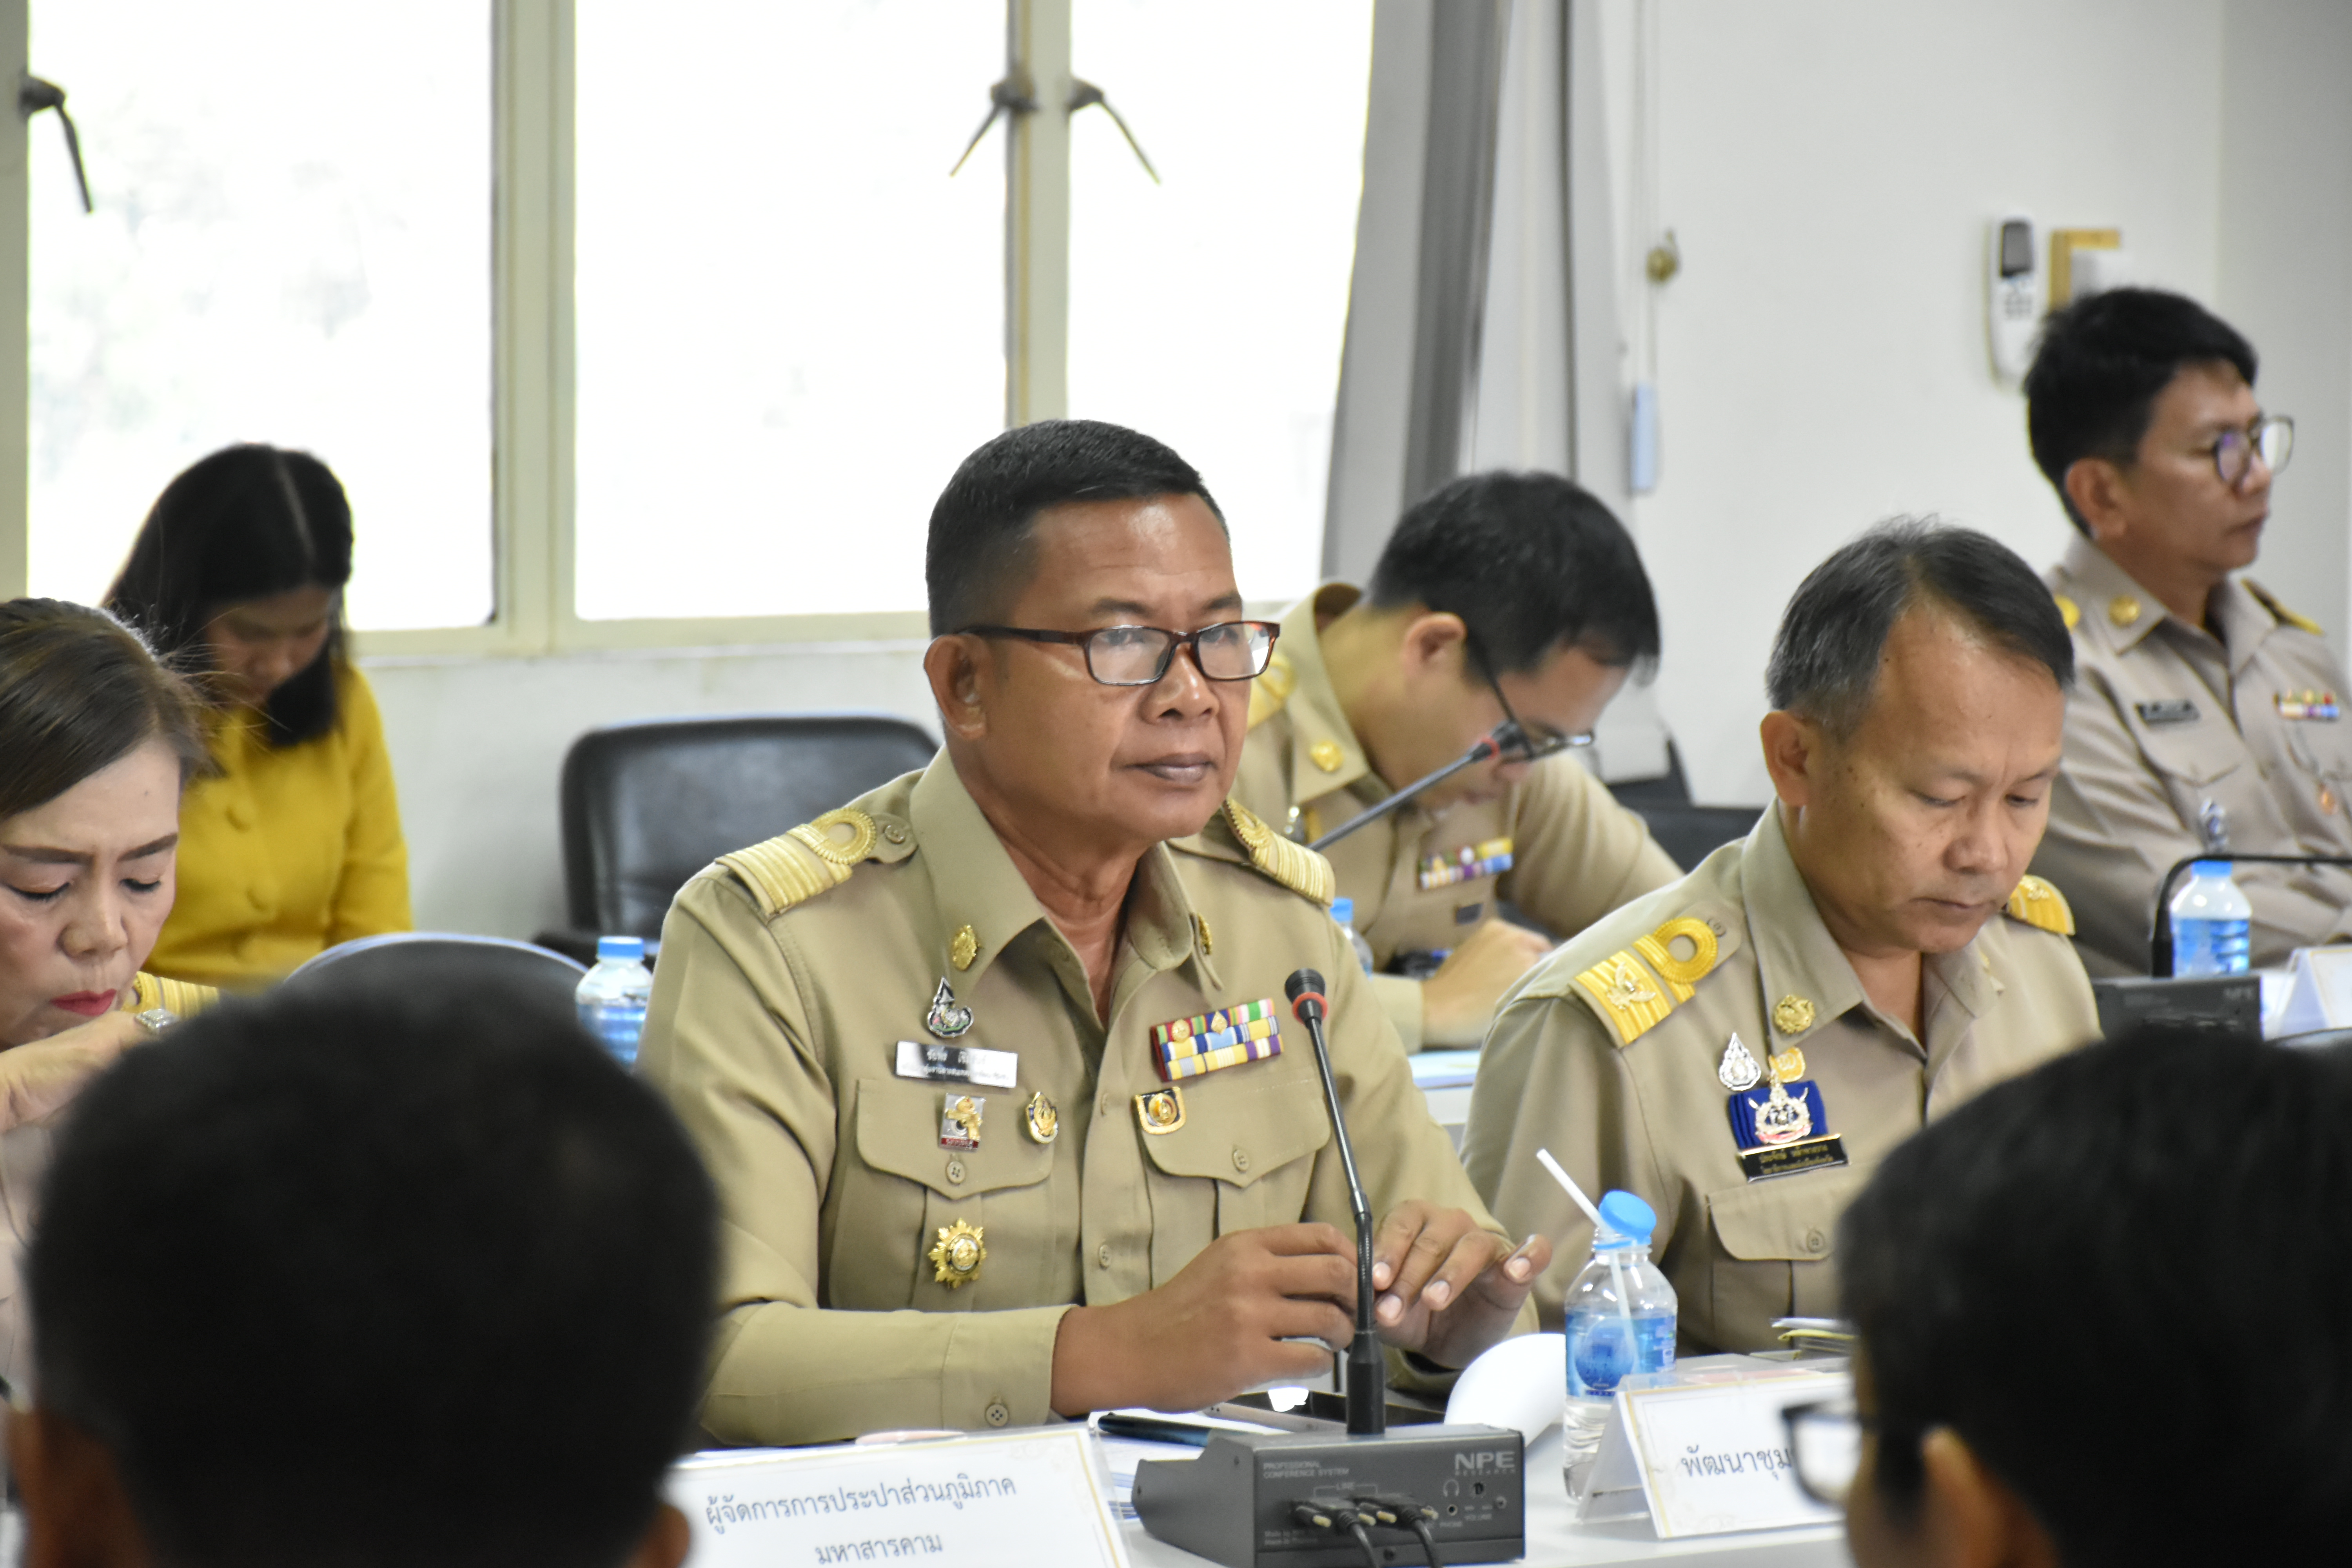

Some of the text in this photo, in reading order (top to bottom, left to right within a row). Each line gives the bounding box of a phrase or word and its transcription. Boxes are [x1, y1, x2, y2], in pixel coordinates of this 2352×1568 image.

[1263, 1468, 1349, 1478] CONFERENCE SYSTEM
[1455, 1451, 1515, 1470] NPE
[1681, 1445, 1792, 1481] พัฒนาชุม
[706, 1473, 1016, 1534] ผู้จัดการการประปาส่วนภูมิภาค
[815, 1533, 943, 1565] มหาสารคาม
